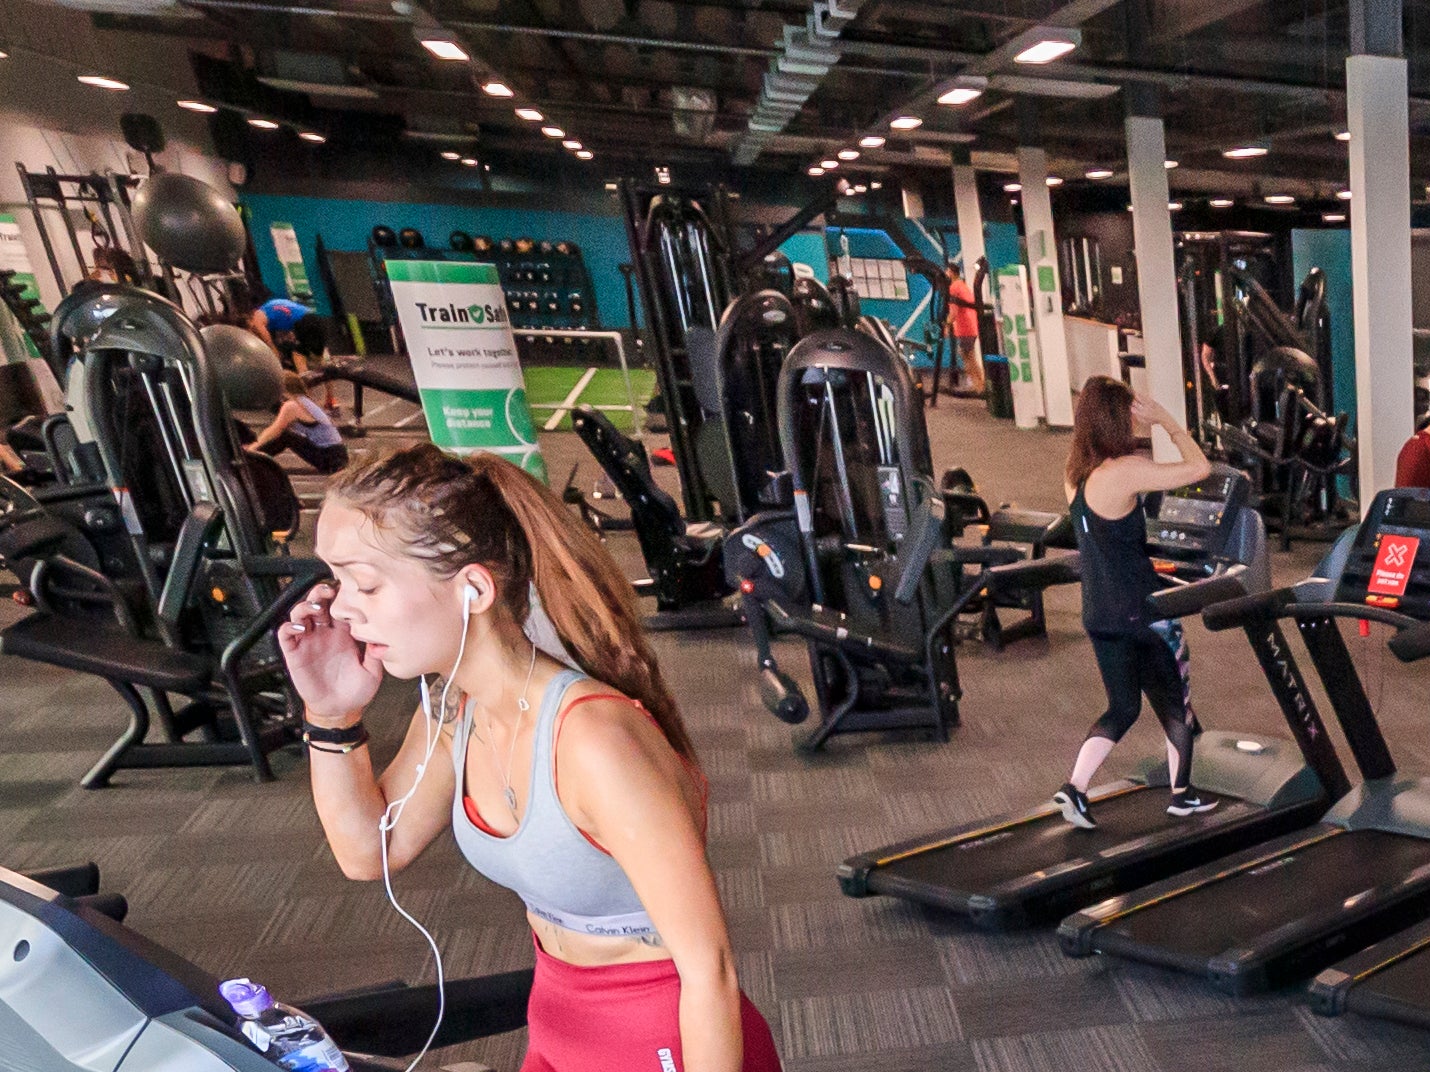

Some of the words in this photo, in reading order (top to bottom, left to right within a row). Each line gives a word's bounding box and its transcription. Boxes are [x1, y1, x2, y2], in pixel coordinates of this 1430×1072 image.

[415, 302, 470, 322] Train
[585, 923, 621, 935] Calvin
[622, 925, 650, 934] Klein
